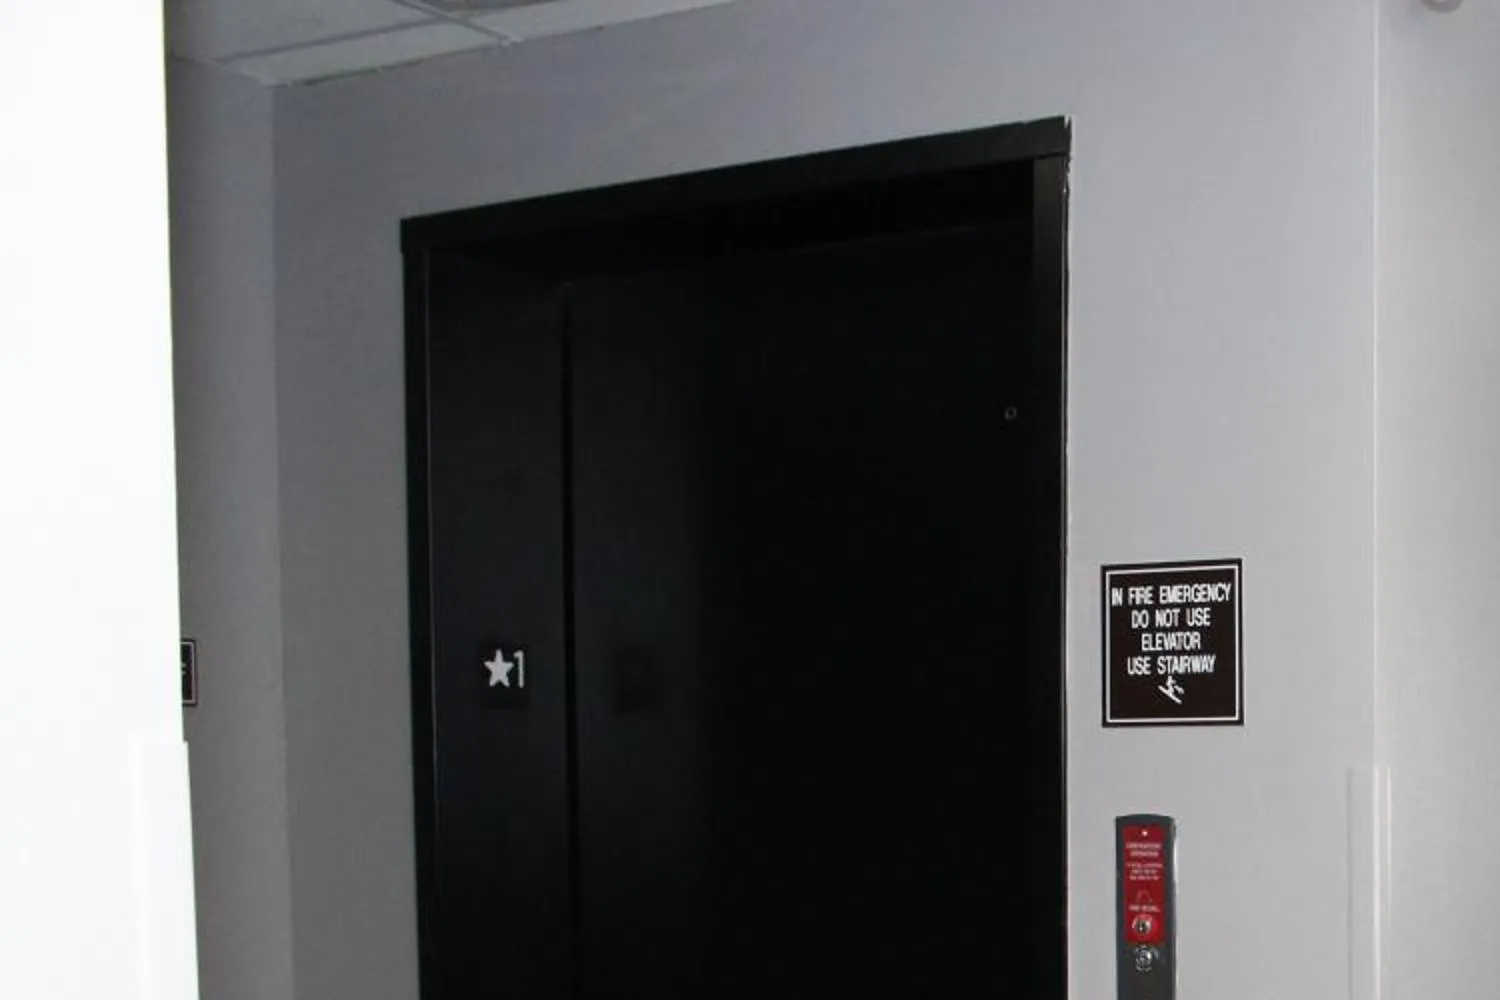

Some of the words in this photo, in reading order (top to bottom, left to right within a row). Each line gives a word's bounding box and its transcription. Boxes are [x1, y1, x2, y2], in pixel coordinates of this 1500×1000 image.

[1111, 587, 1123, 606] IN
[1128, 586, 1153, 605] FIRE
[1159, 582, 1231, 604] EMERGENCY
[1131, 609, 1149, 628] DO
[1155, 608, 1181, 627] NOT
[1186, 607, 1211, 626] USE
[1141, 631, 1201, 651] ELEVATOR
[1127, 656, 1151, 675] USE
[1157, 654, 1216, 674] STAIRWAY
